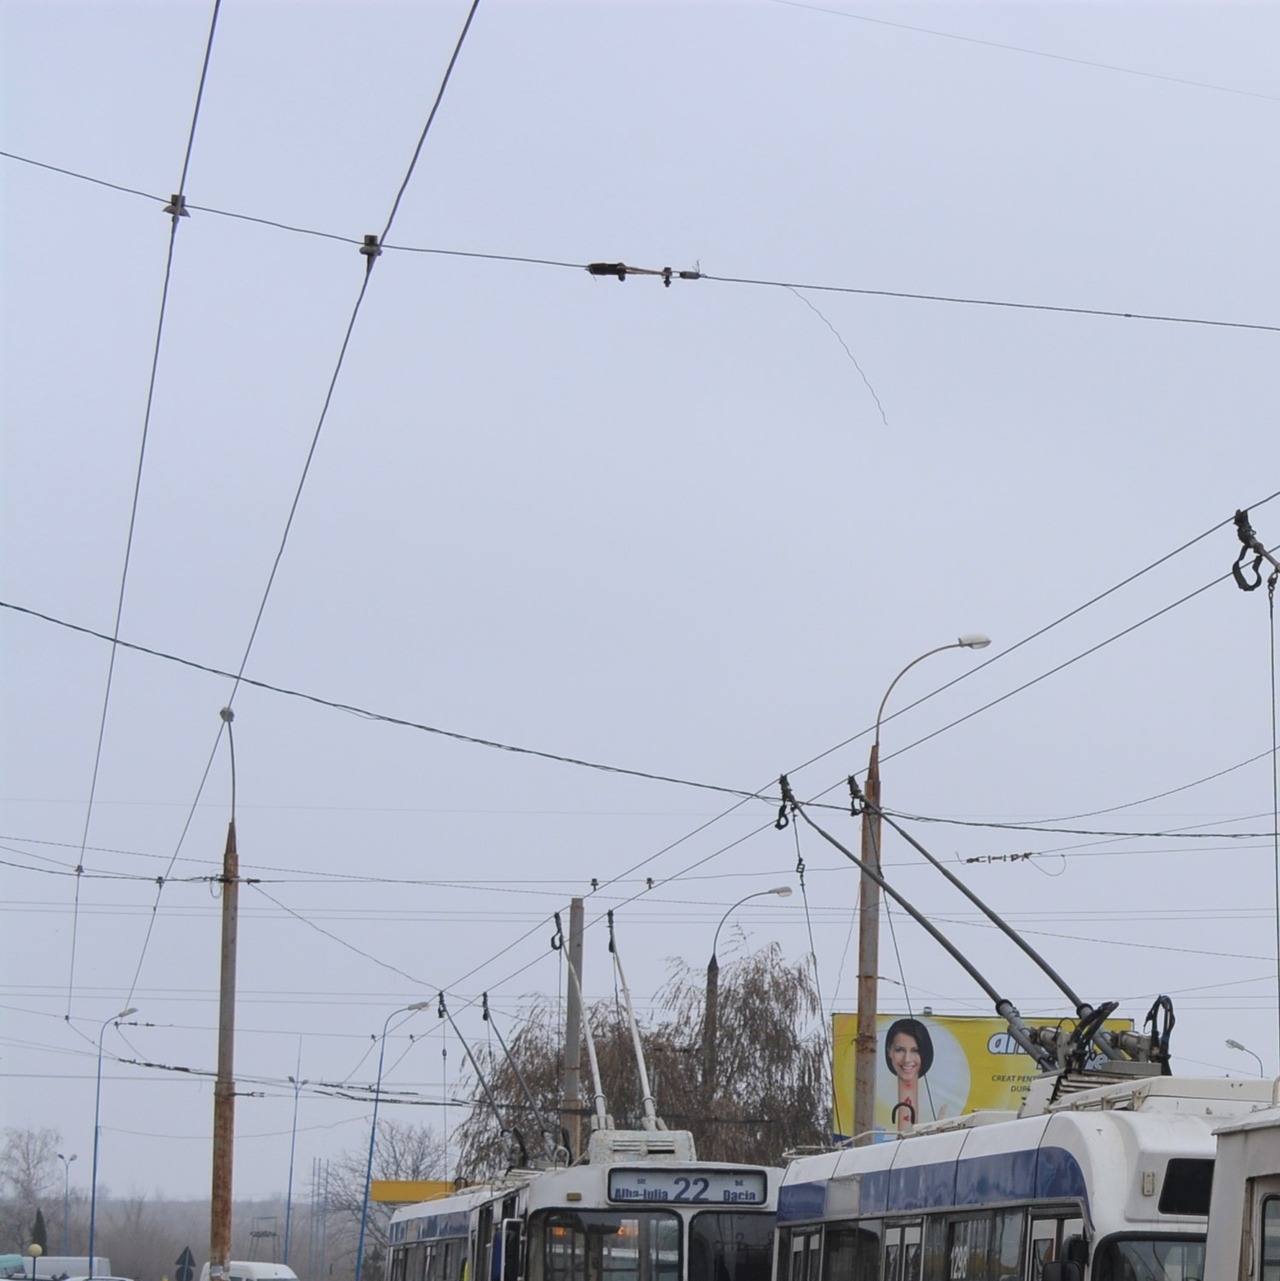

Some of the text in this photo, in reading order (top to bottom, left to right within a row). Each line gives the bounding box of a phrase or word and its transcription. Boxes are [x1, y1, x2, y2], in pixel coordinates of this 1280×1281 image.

[991, 1074, 1016, 1083] CREAT
[614, 1187, 669, 1201] Alba-Iulia
[673, 1176, 710, 1201] 22
[722, 1188, 757, 1202] Dacia
